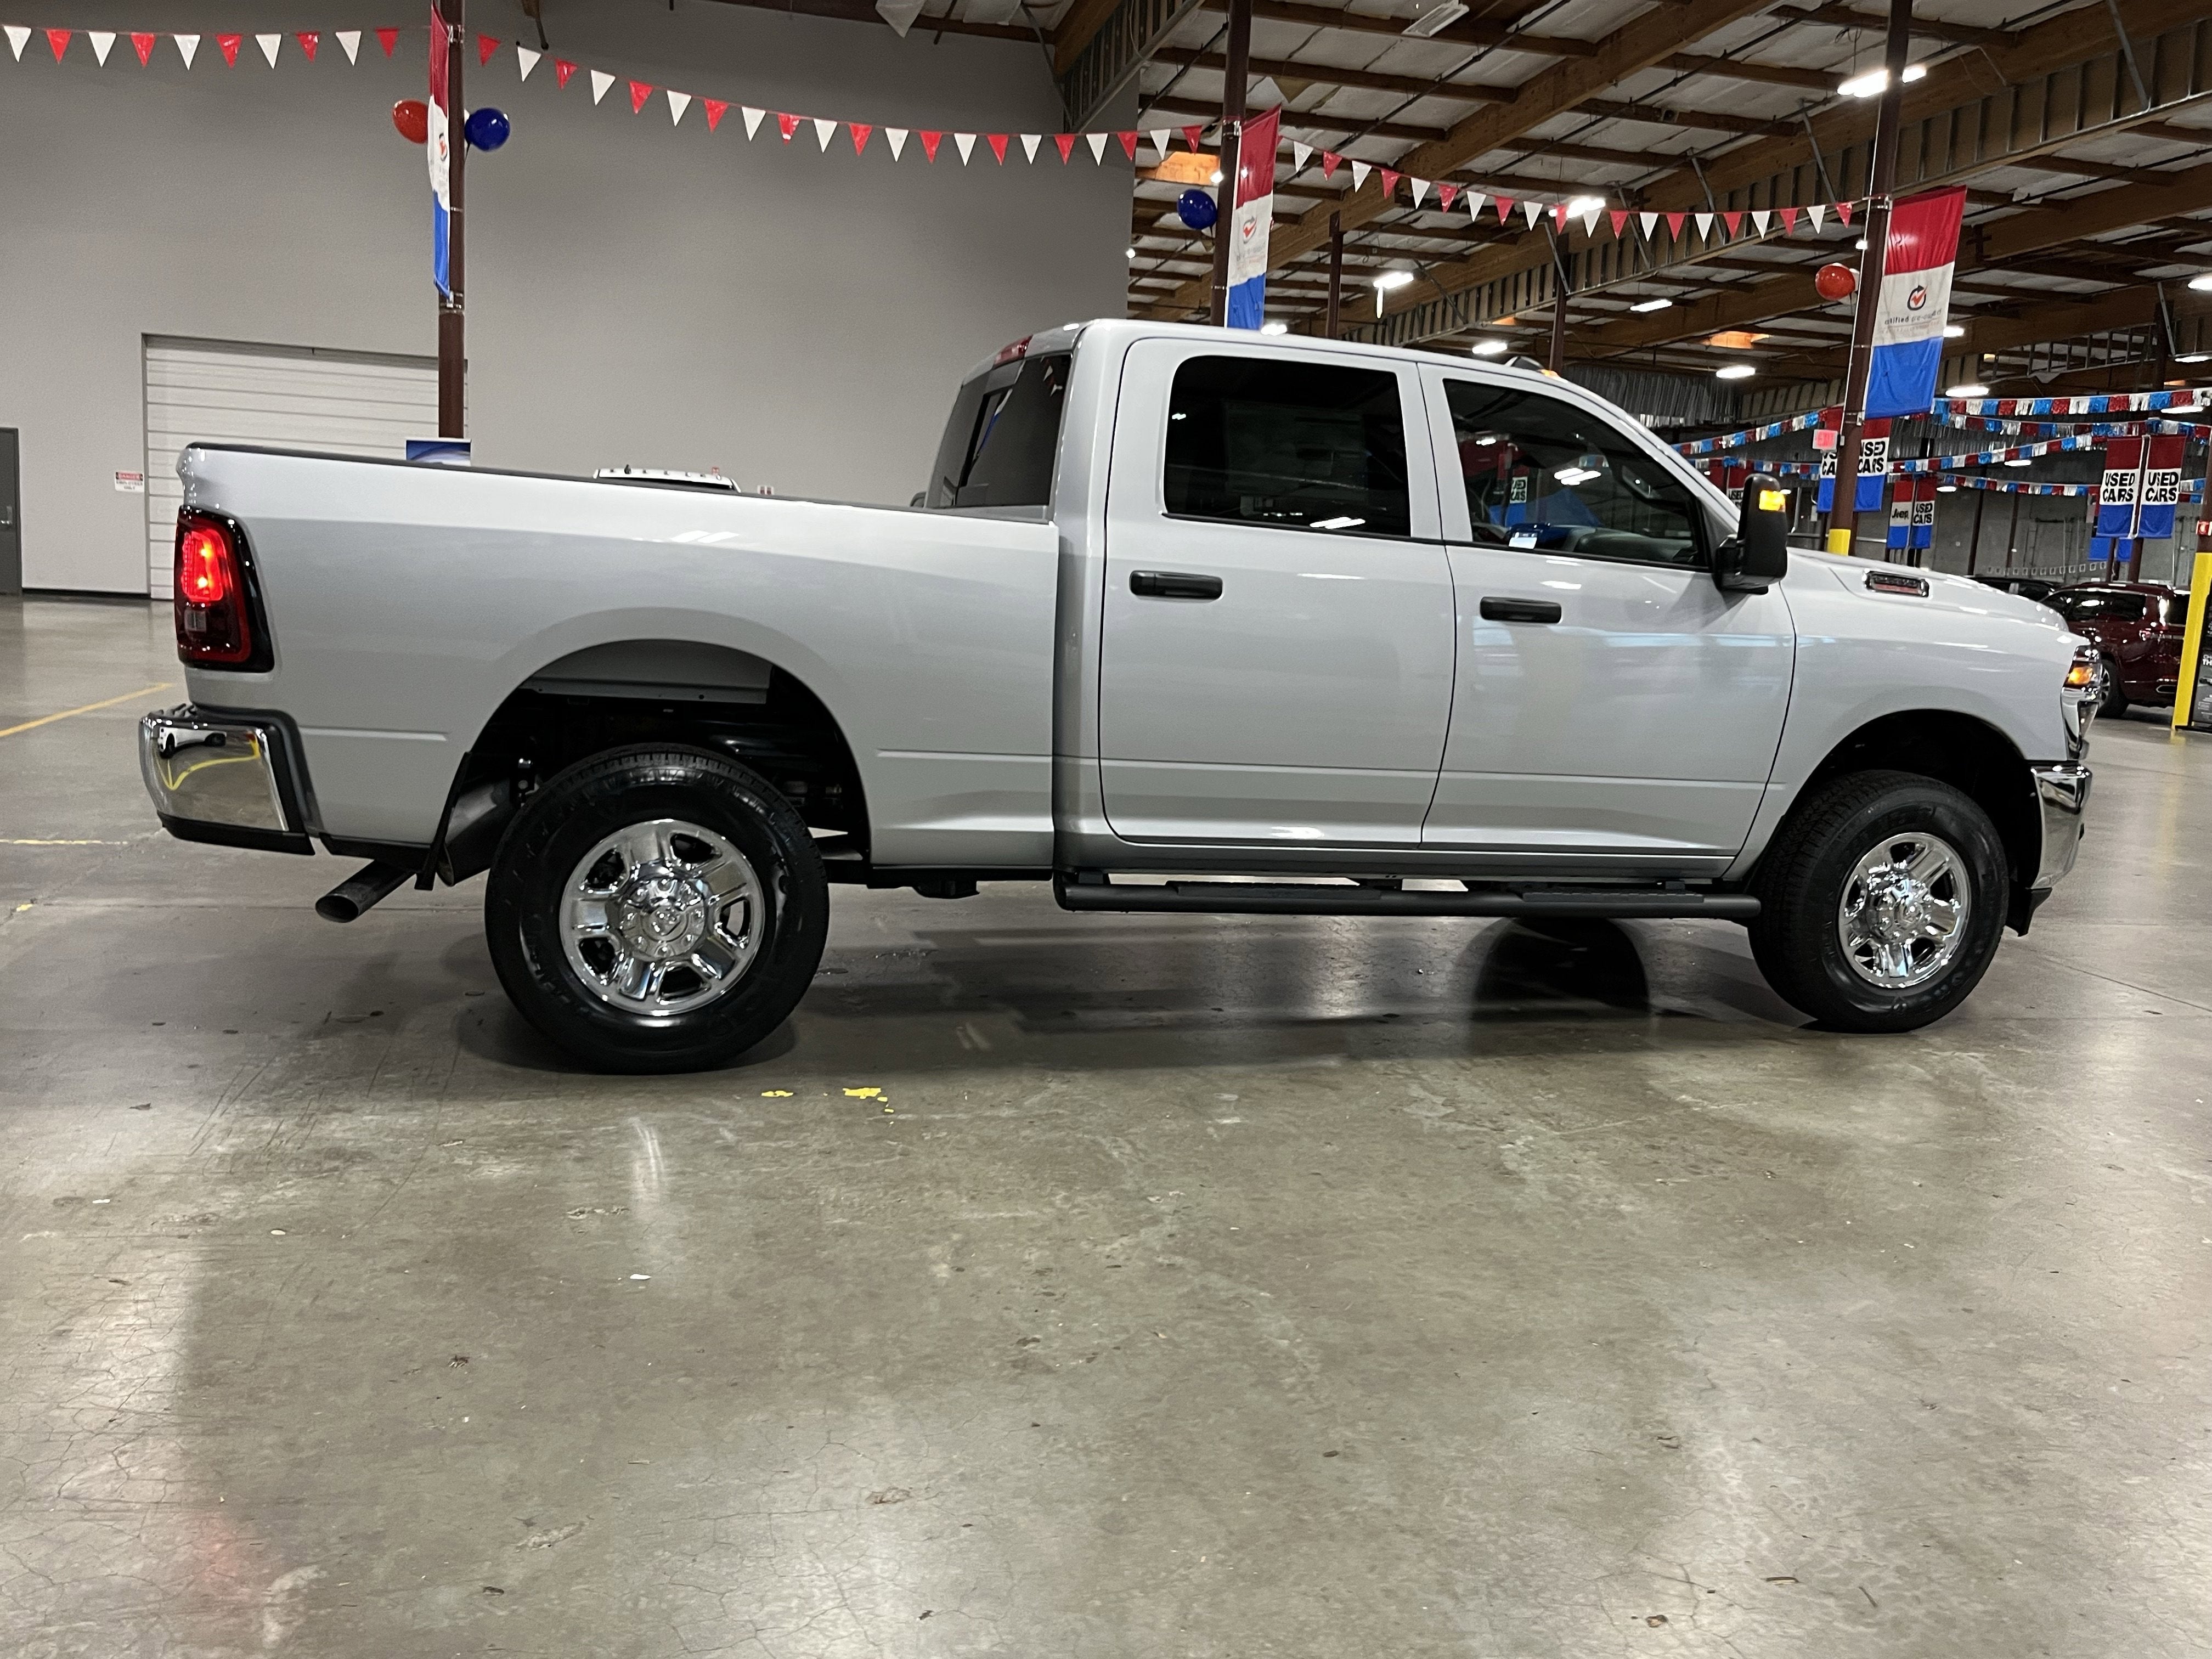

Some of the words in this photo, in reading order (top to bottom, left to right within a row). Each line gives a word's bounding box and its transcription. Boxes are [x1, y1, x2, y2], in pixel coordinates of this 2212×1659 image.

[1822, 461, 1836, 475] CA
[2105, 472, 2135, 486] USED
[2148, 472, 2179, 486] USED
[2102, 488, 2134, 502] CARS
[2145, 488, 2177, 502] CARS
